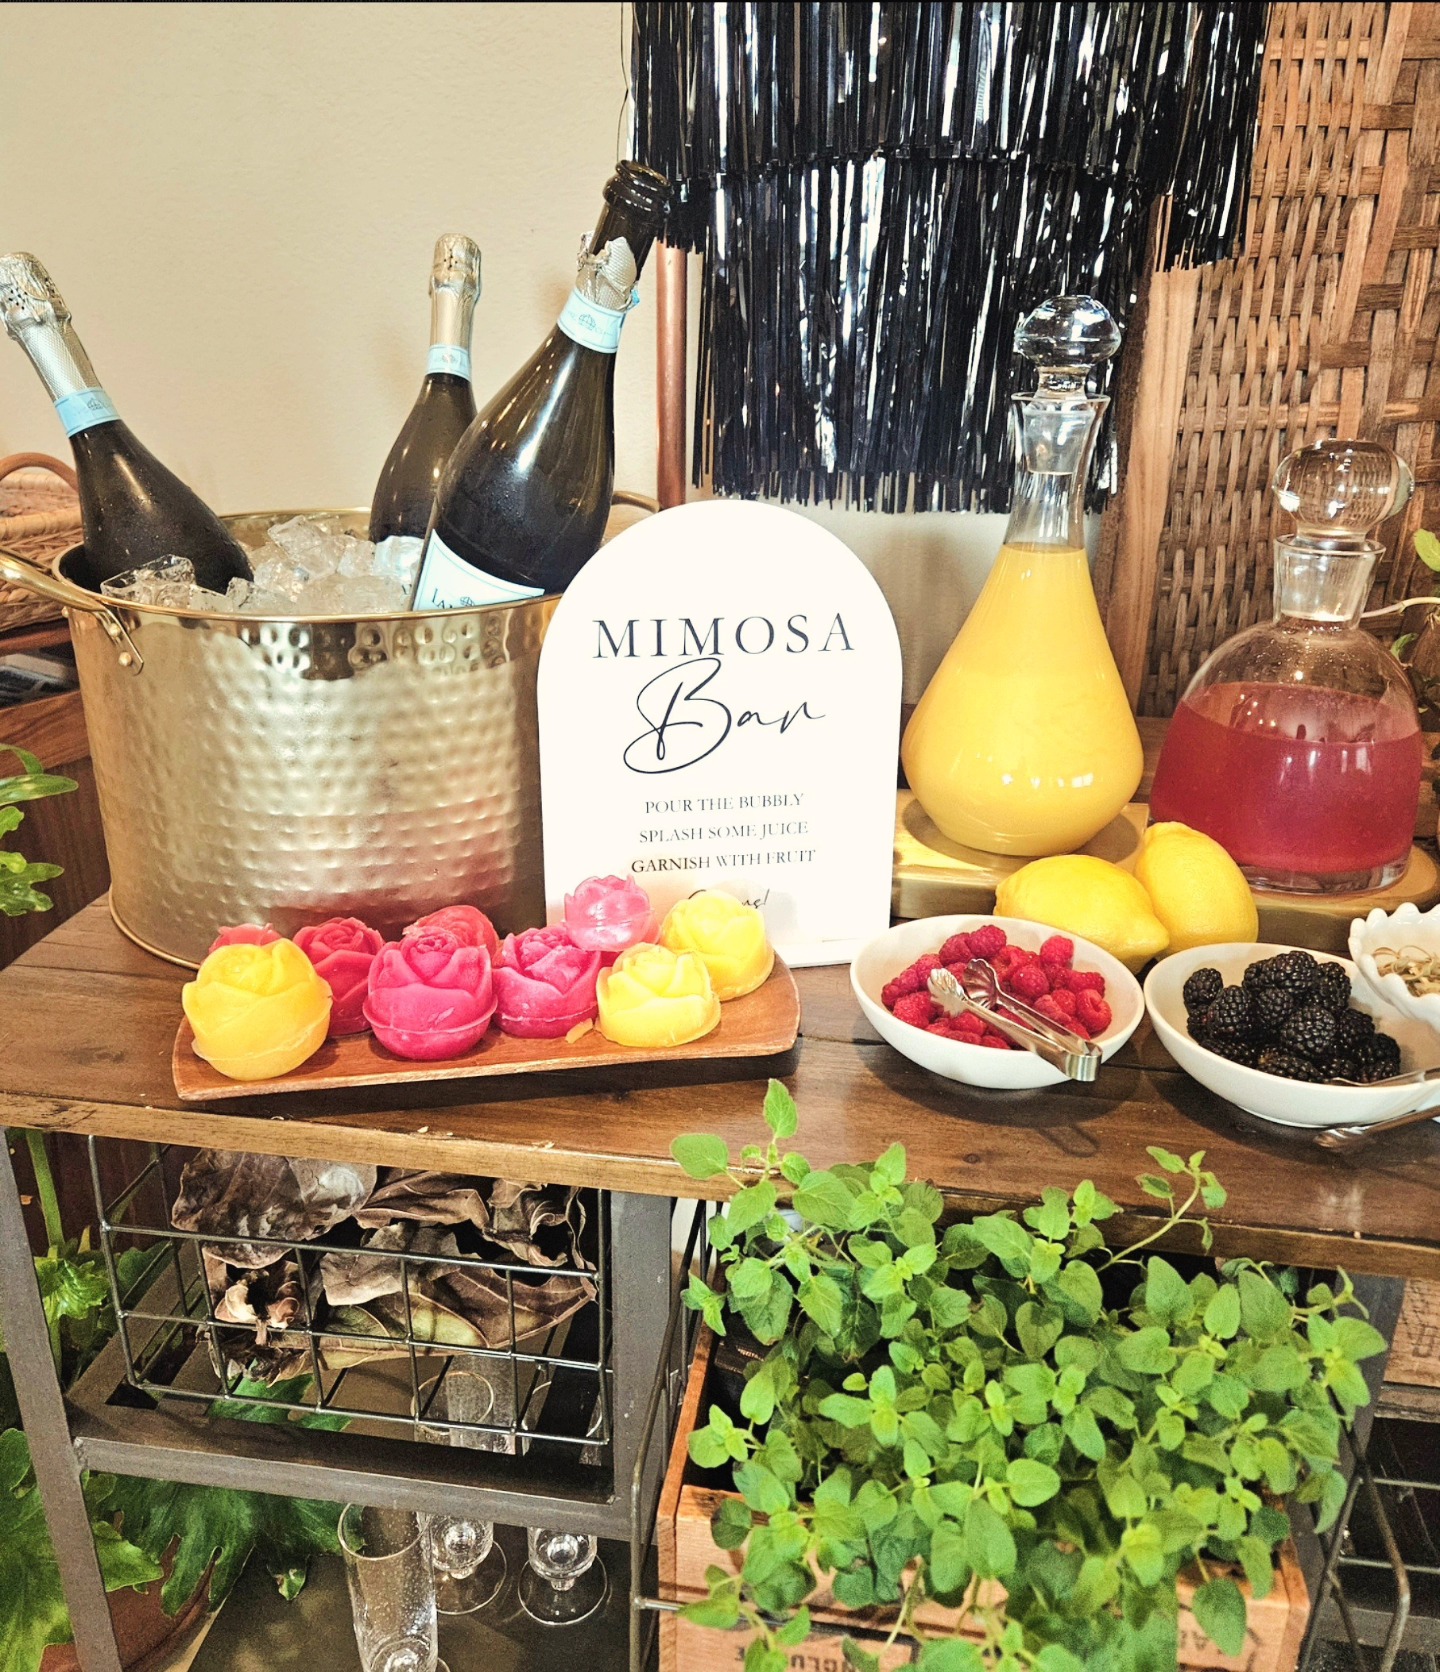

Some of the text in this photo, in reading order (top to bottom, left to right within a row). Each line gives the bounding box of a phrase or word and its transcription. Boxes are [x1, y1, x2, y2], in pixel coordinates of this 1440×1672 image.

[592, 612, 855, 658] MIMOSA
[623, 657, 826, 775] Bar
[645, 792, 804, 814] POUR THE BUBBLY
[639, 821, 808, 844] SPLASH SOME JUICE
[630, 849, 816, 873] GARNISH WITH FRUIT
